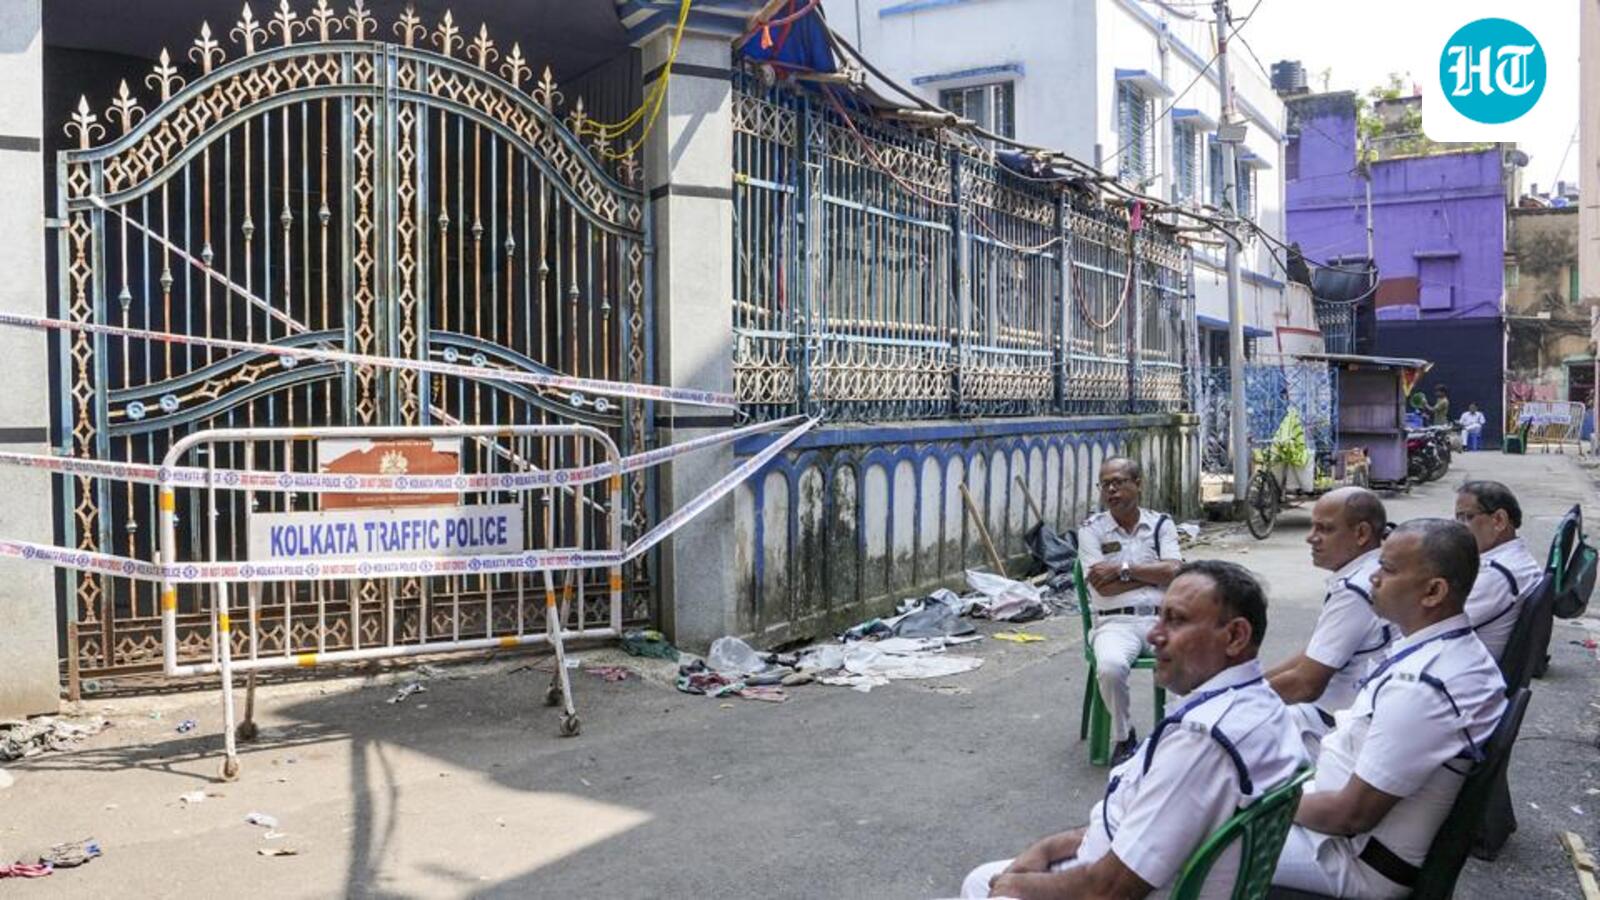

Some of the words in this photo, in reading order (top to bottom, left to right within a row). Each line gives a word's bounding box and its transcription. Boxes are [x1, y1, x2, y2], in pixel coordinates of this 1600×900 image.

[271, 523, 358, 557] KOLKATA
[364, 519, 440, 552] TRAFFIC
[445, 515, 508, 548] POLICE
